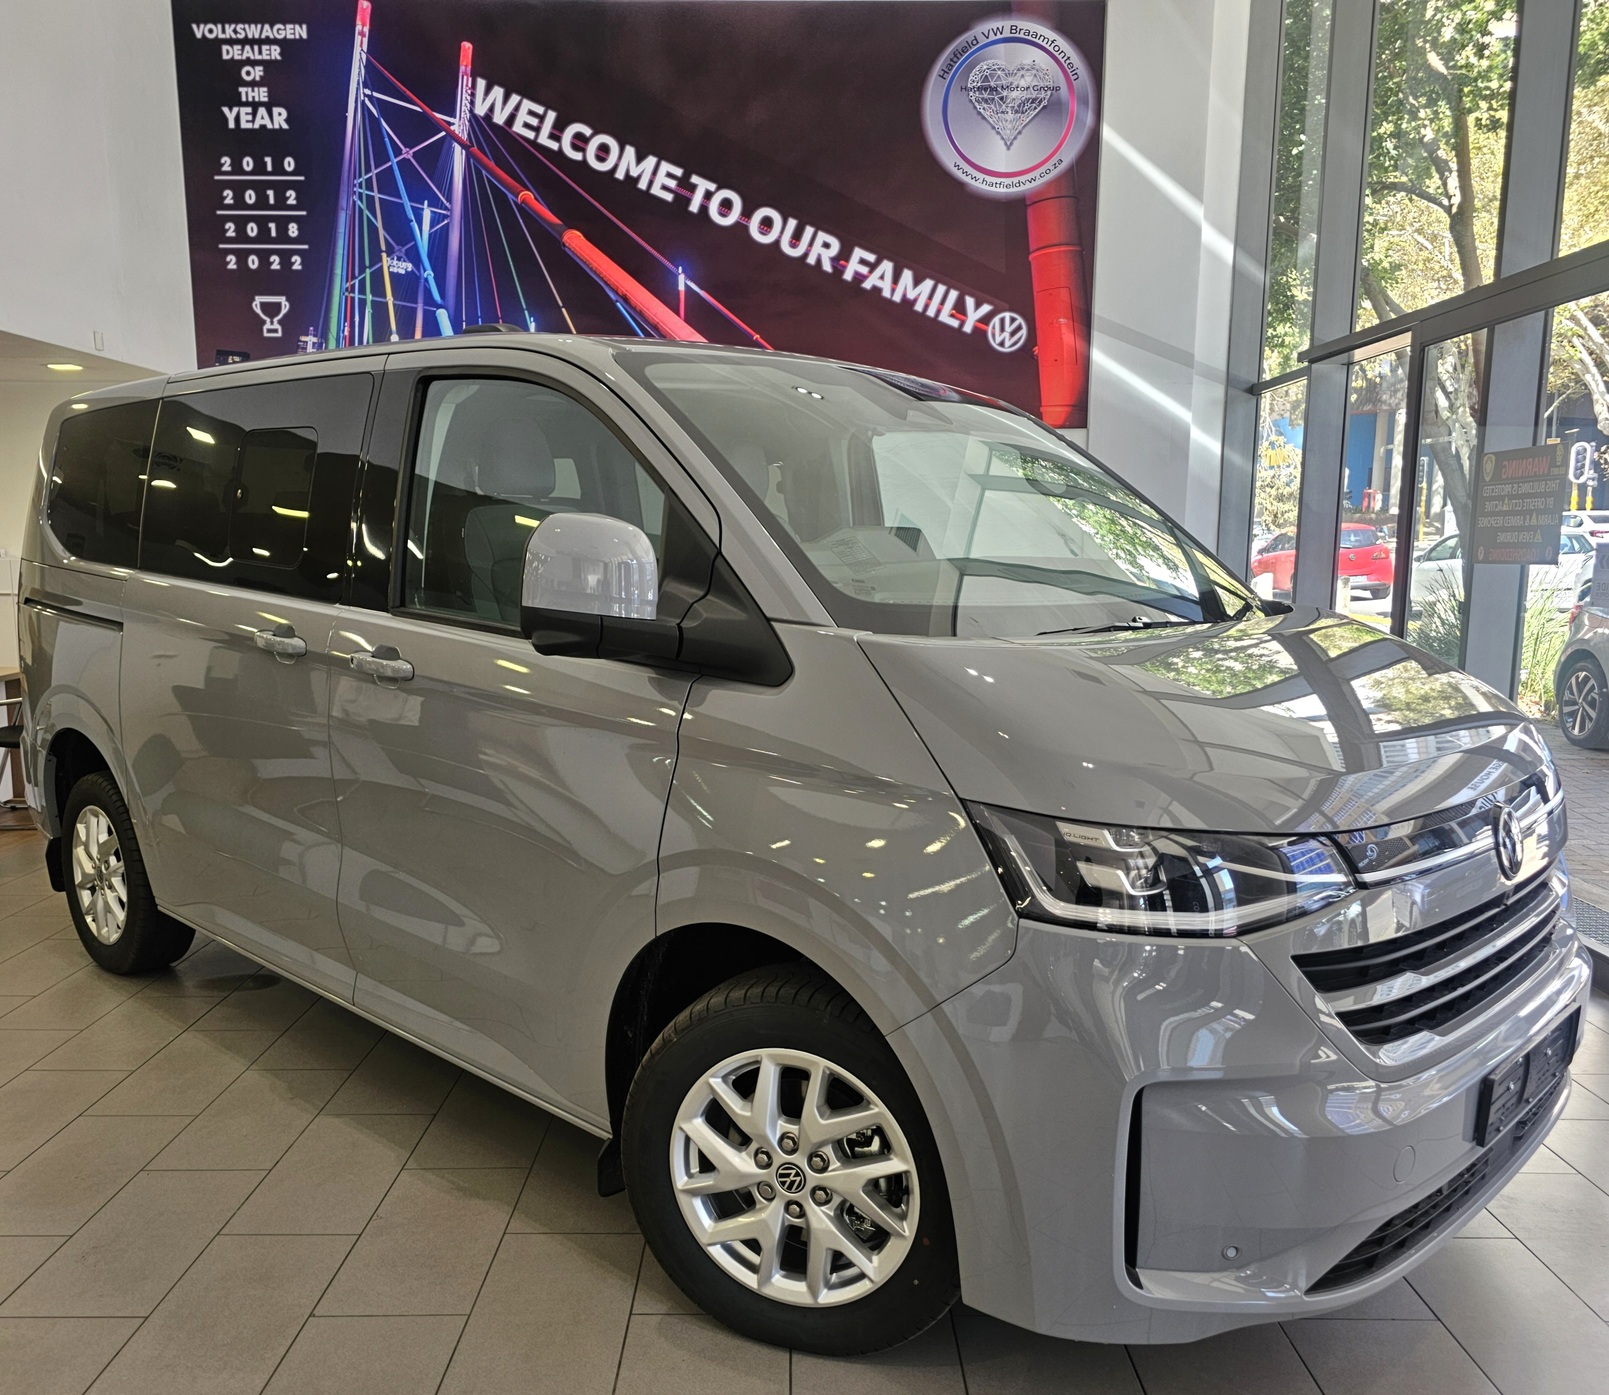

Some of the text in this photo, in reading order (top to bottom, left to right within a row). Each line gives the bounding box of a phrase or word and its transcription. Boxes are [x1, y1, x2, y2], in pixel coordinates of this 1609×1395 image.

[191, 23, 308, 39] VOLKSWAGEN
[221, 45, 282, 60] DEALER
[938, 24, 1080, 82] Hatfield VW Braamfontein
[240, 66, 264, 81] OF
[238, 87, 268, 102] THE
[1001, 84, 1031, 92] Motor
[1032, 84, 1061, 94] Group
[221, 106, 289, 129] YEAR
[220, 156, 296, 172] 2010
[953, 158, 1064, 190] www.hatfieldvw.co.za
[222, 189, 297, 205] 2012
[473, 76, 995, 336] WELCOME TO OUR FAMILY
[224, 222, 299, 238] 2018
[225, 255, 302, 270] 2022
